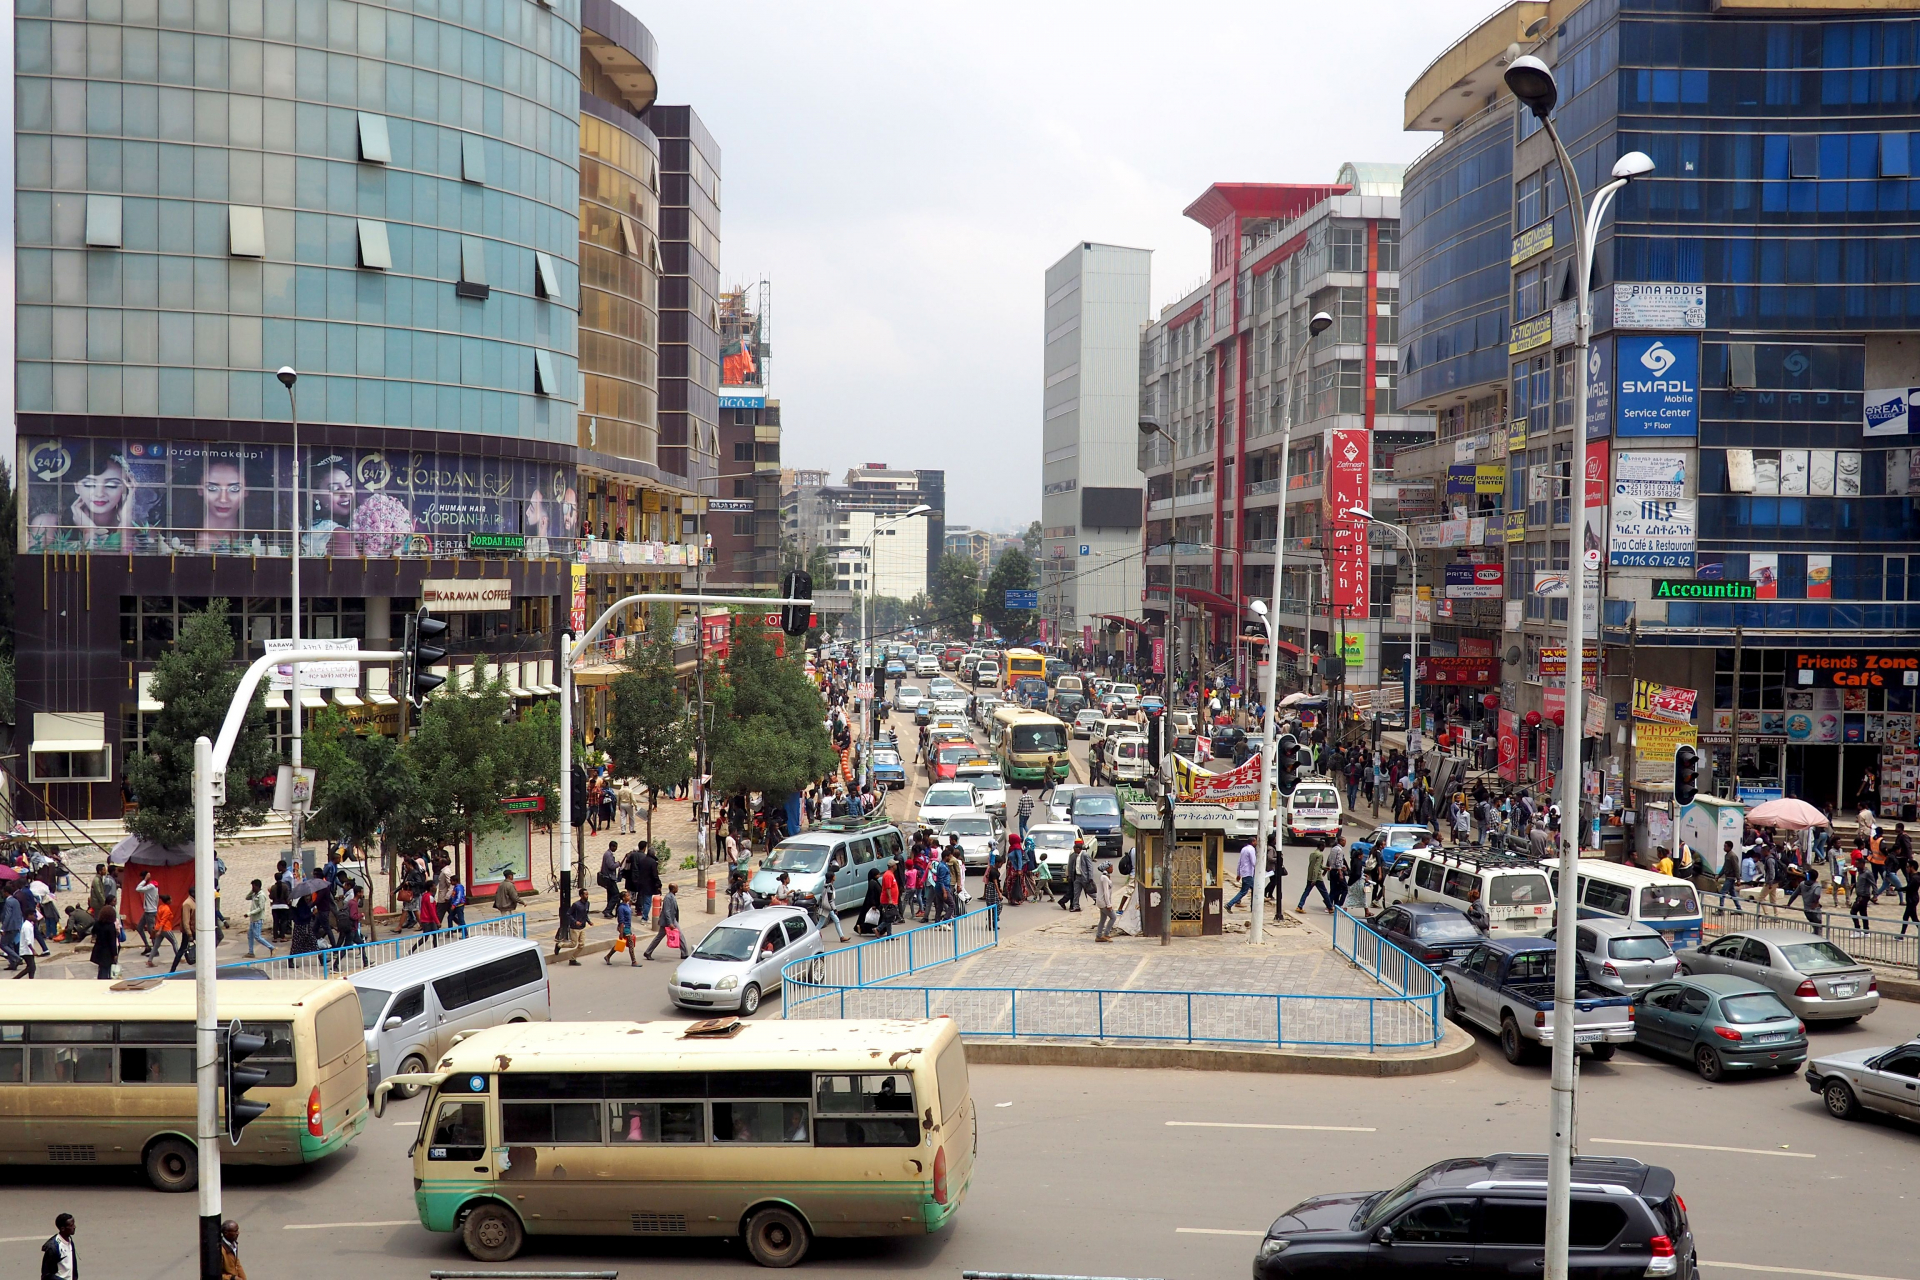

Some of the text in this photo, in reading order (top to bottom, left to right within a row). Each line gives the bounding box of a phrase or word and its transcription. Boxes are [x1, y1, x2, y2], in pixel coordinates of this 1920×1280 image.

[1512, 222, 1552, 254] X-TIGI Mobile
[1632, 286, 1703, 295] BINA ADDIS
[1510, 316, 1551, 342] X-TIGI Mobile
[1586, 381, 1608, 399] MADL
[1622, 380, 1694, 393] SMADL
[1596, 398, 1608, 408] Mobile
[1664, 394, 1694, 403] Mobile
[1733, 392, 1855, 404] SMADL
[1624, 408, 1692, 418] Service Center
[1866, 404, 1907, 415] GREAT
[1594, 412, 1606, 421] Center
[1510, 420, 1526, 434] X-TIGI
[1644, 422, 1652, 430] 3rd
[166, 448, 264, 460] jordanmakeup1
[37, 457, 62, 468] 24/7
[1588, 460, 1598, 473] itel
[364, 468, 385, 480] 24/7
[1355, 474, 1364, 509] EID
[1507, 514, 1524, 526] X-TIGI
[471, 536, 524, 547] JORDAN HAIR
[1612, 538, 1694, 552] Tiya Café & Restaurant
[1082, 546, 1087, 554] P
[1354, 519, 1364, 607] MUBARAK
[1622, 554, 1690, 566] 0116 67 42 42
[436, 590, 509, 600] KARAVAN COFFEE
[1797, 655, 1919, 669] Friends Zone
[1833, 672, 1884, 686] Café
